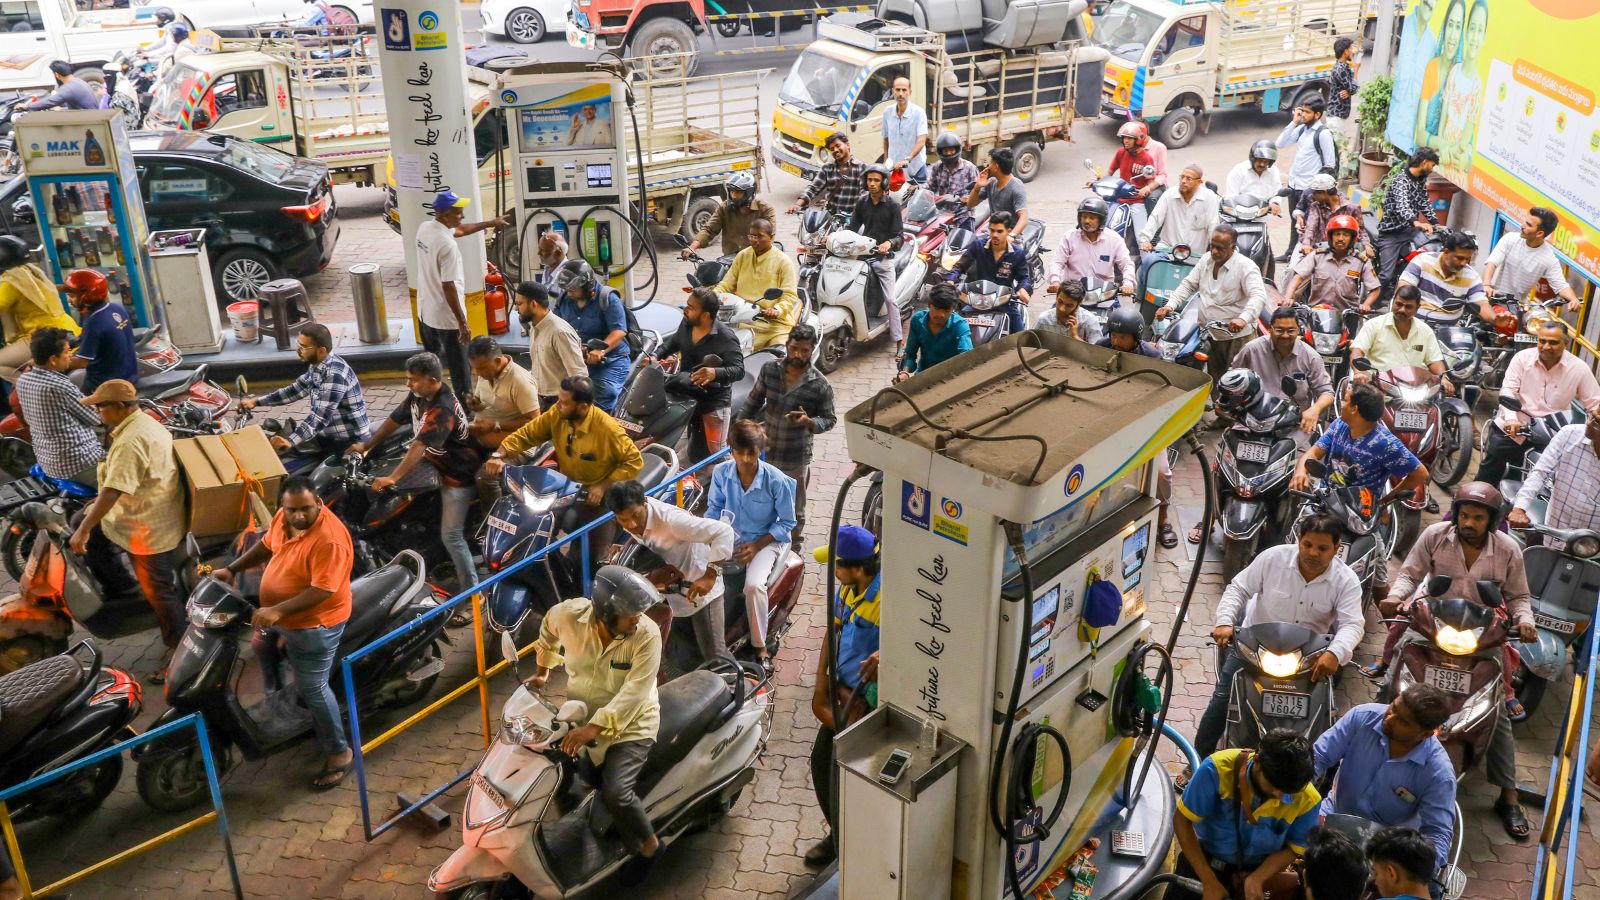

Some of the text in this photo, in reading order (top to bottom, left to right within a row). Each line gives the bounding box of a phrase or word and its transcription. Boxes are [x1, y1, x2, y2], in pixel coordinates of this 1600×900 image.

[406, 61, 433, 86] kar
[408, 92, 443, 126] feel
[414, 128, 440, 146] ko
[46, 140, 80, 151] MAK
[424, 152, 450, 193] future
[1401, 413, 1424, 422] TS12E
[935, 522, 967, 541] Petroleum
[940, 519, 961, 533] Bharat
[914, 554, 952, 721] future ko feel kar
[1433, 668, 1466, 682] TS09F
[1432, 678, 1465, 692] T6234
[1271, 694, 1303, 707] TS11E
[1270, 703, 1302, 717] V6047
